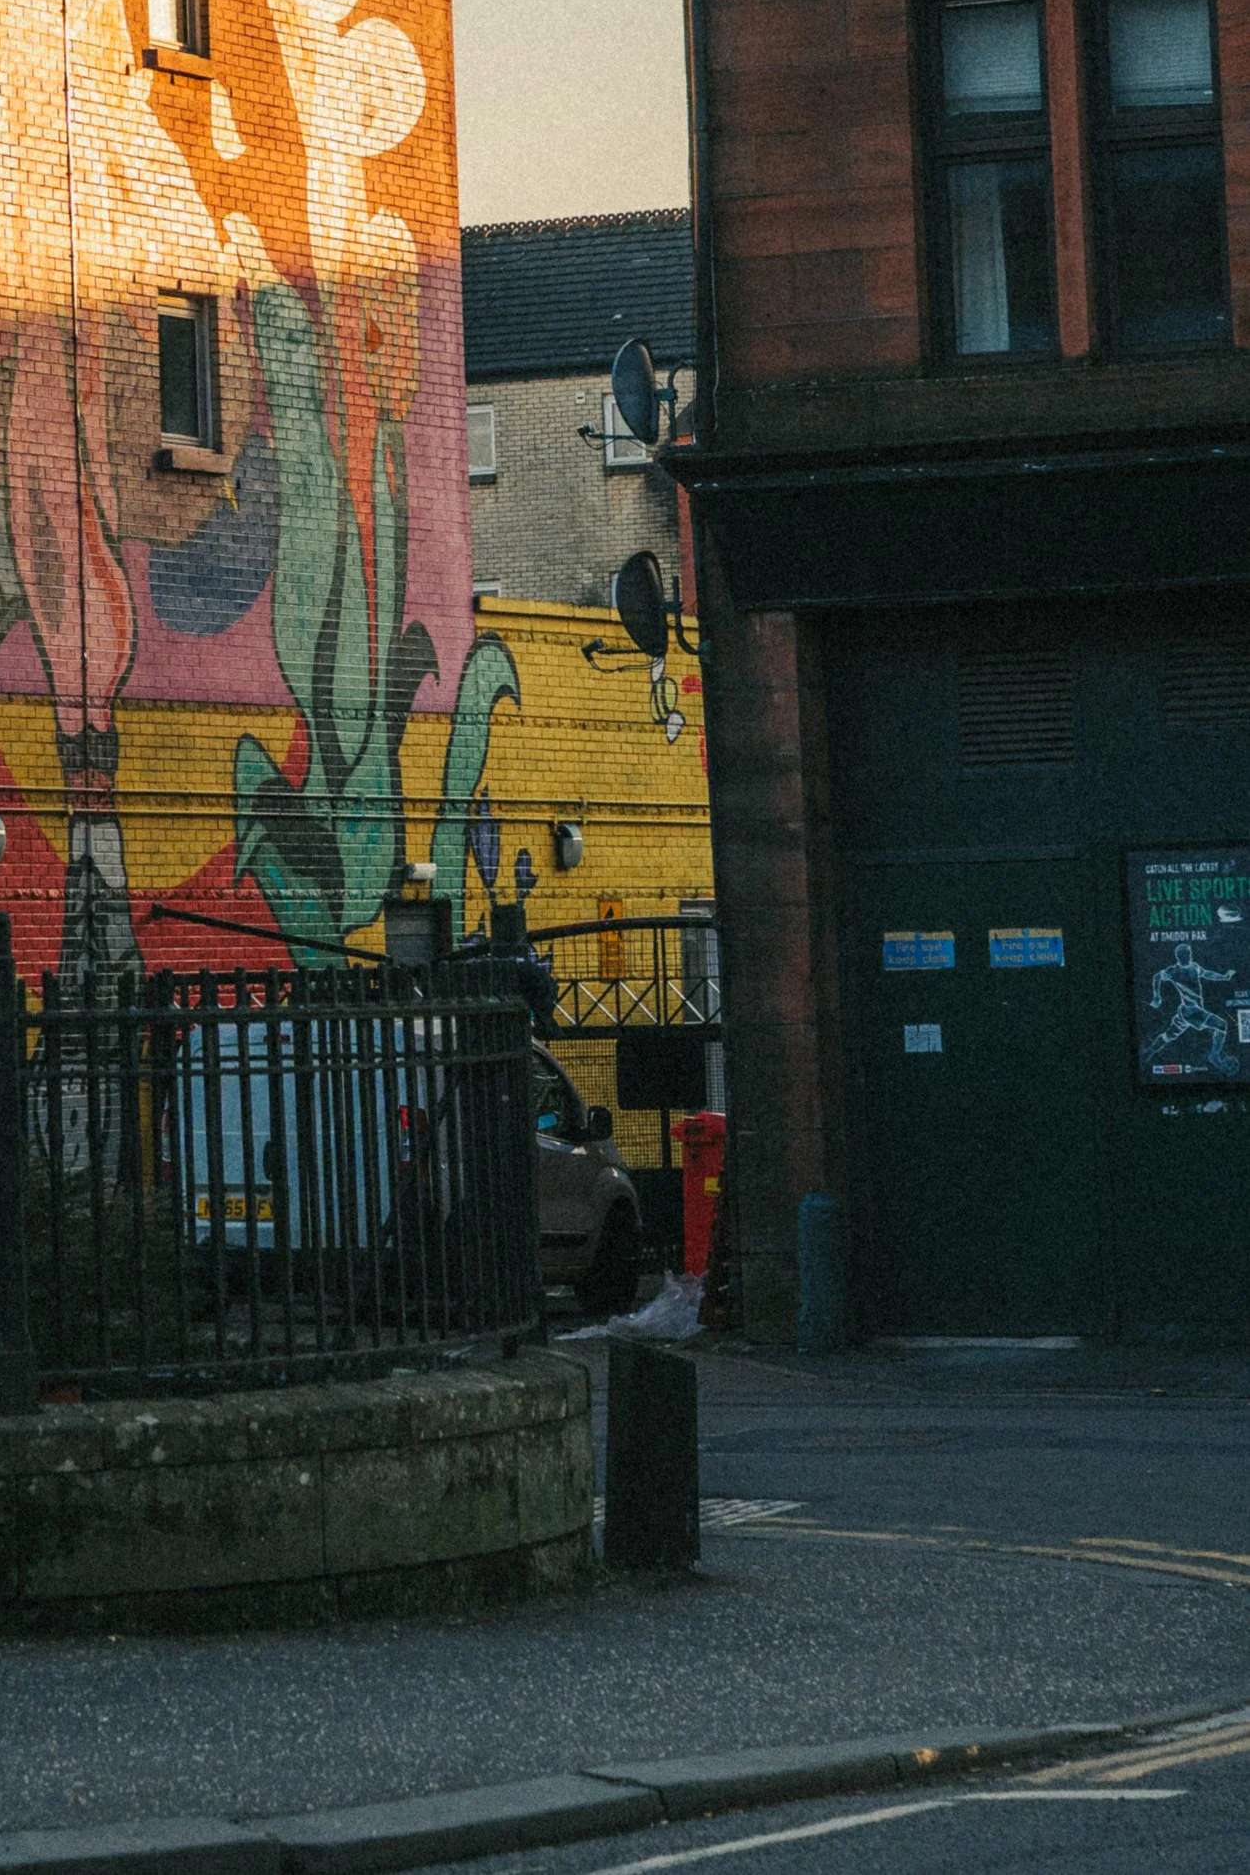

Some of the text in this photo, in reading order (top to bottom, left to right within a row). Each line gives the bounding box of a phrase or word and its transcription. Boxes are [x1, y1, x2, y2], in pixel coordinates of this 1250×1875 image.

[1145, 878, 1183, 901] LIVE
[1149, 903, 1213, 927] ACTION
[1150, 931, 1159, 942] AT
